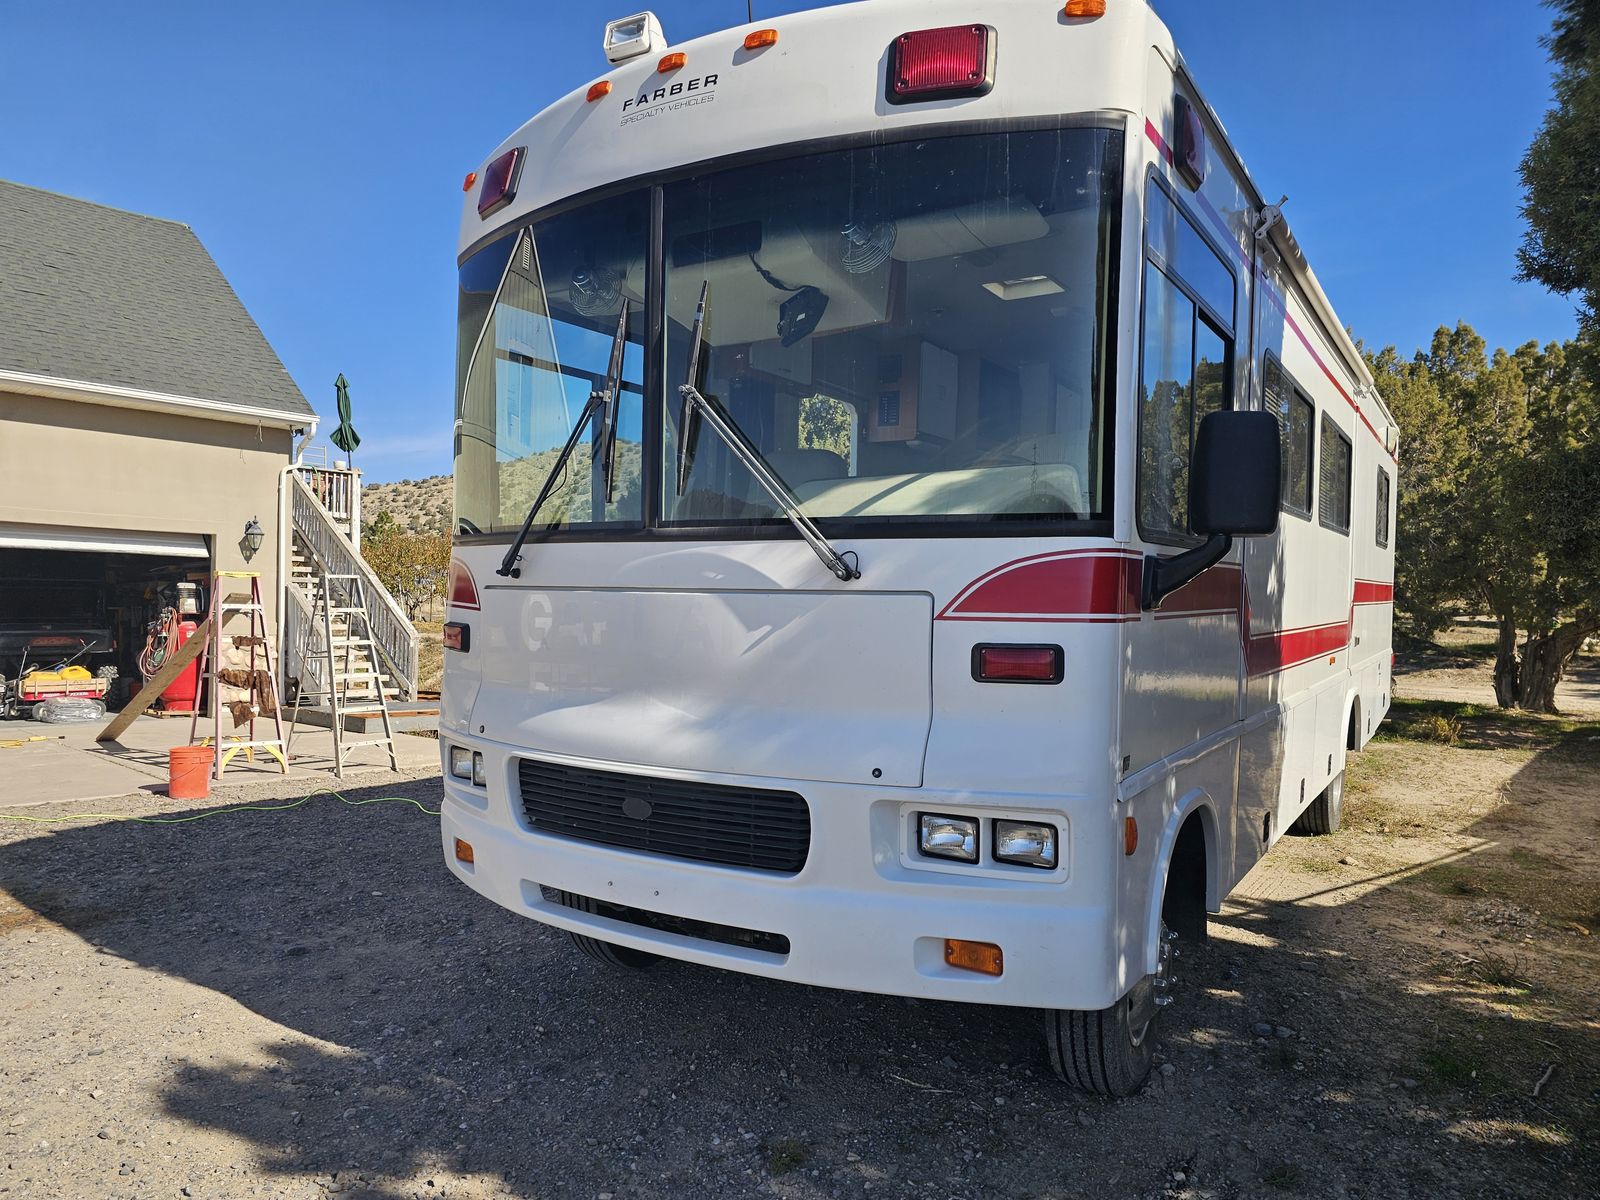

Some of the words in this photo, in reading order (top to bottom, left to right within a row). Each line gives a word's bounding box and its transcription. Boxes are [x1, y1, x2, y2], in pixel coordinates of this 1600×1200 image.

[620, 106, 665, 127] SPECIALTY
[668, 94, 715, 112] VEHICLES
[622, 74, 719, 112] FARBER
